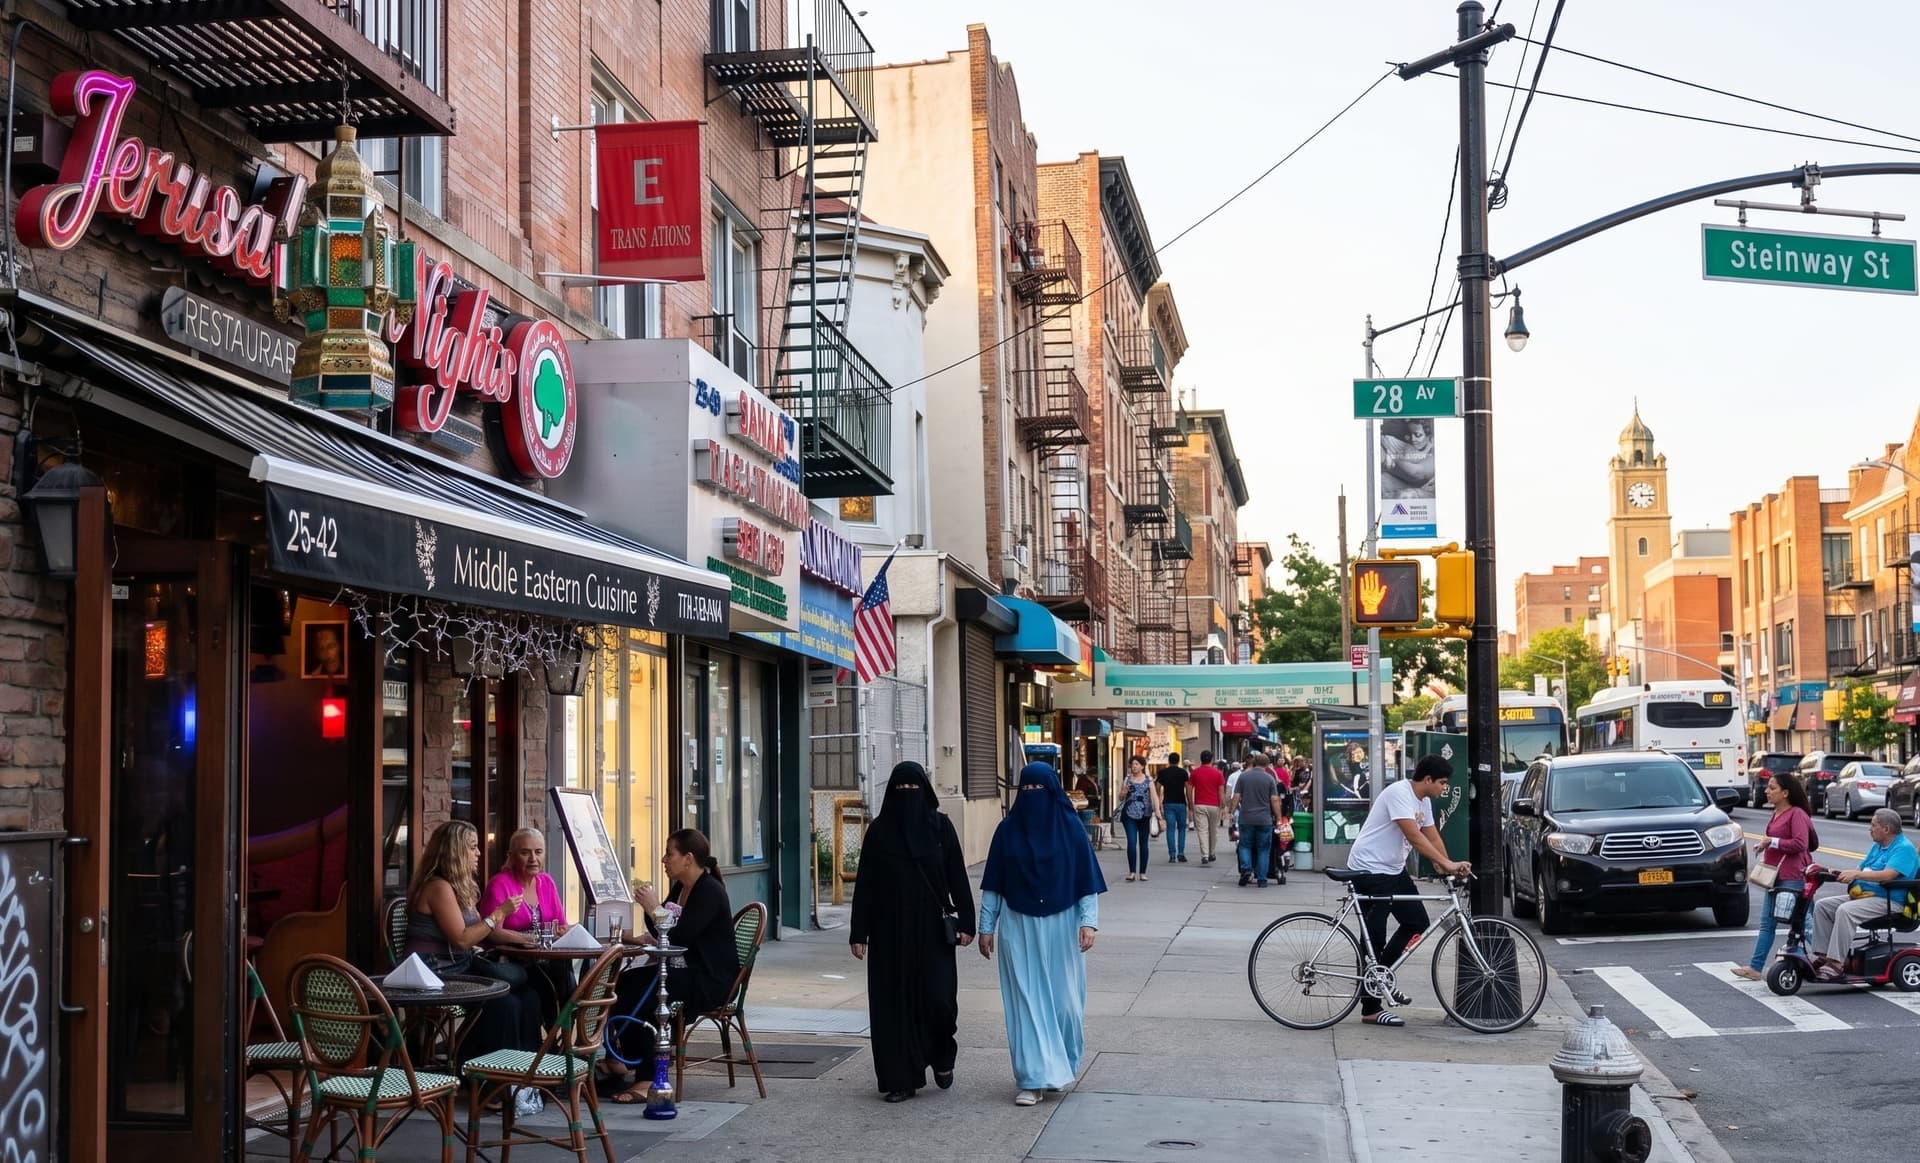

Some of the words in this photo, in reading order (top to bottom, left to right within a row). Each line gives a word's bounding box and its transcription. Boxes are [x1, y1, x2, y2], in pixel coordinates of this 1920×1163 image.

[40, 70, 308, 279] Jerusal
[633, 158, 664, 205] E
[1731, 240, 1853, 284] Steinway
[1863, 250, 1890, 280] St
[1372, 384, 1404, 414] 28
[1415, 384, 1436, 400] Av
[286, 508, 338, 559] 25-42
[453, 543, 518, 595] Middle
[523, 560, 582, 606] Eastern
[585, 572, 638, 616] Cuisine
